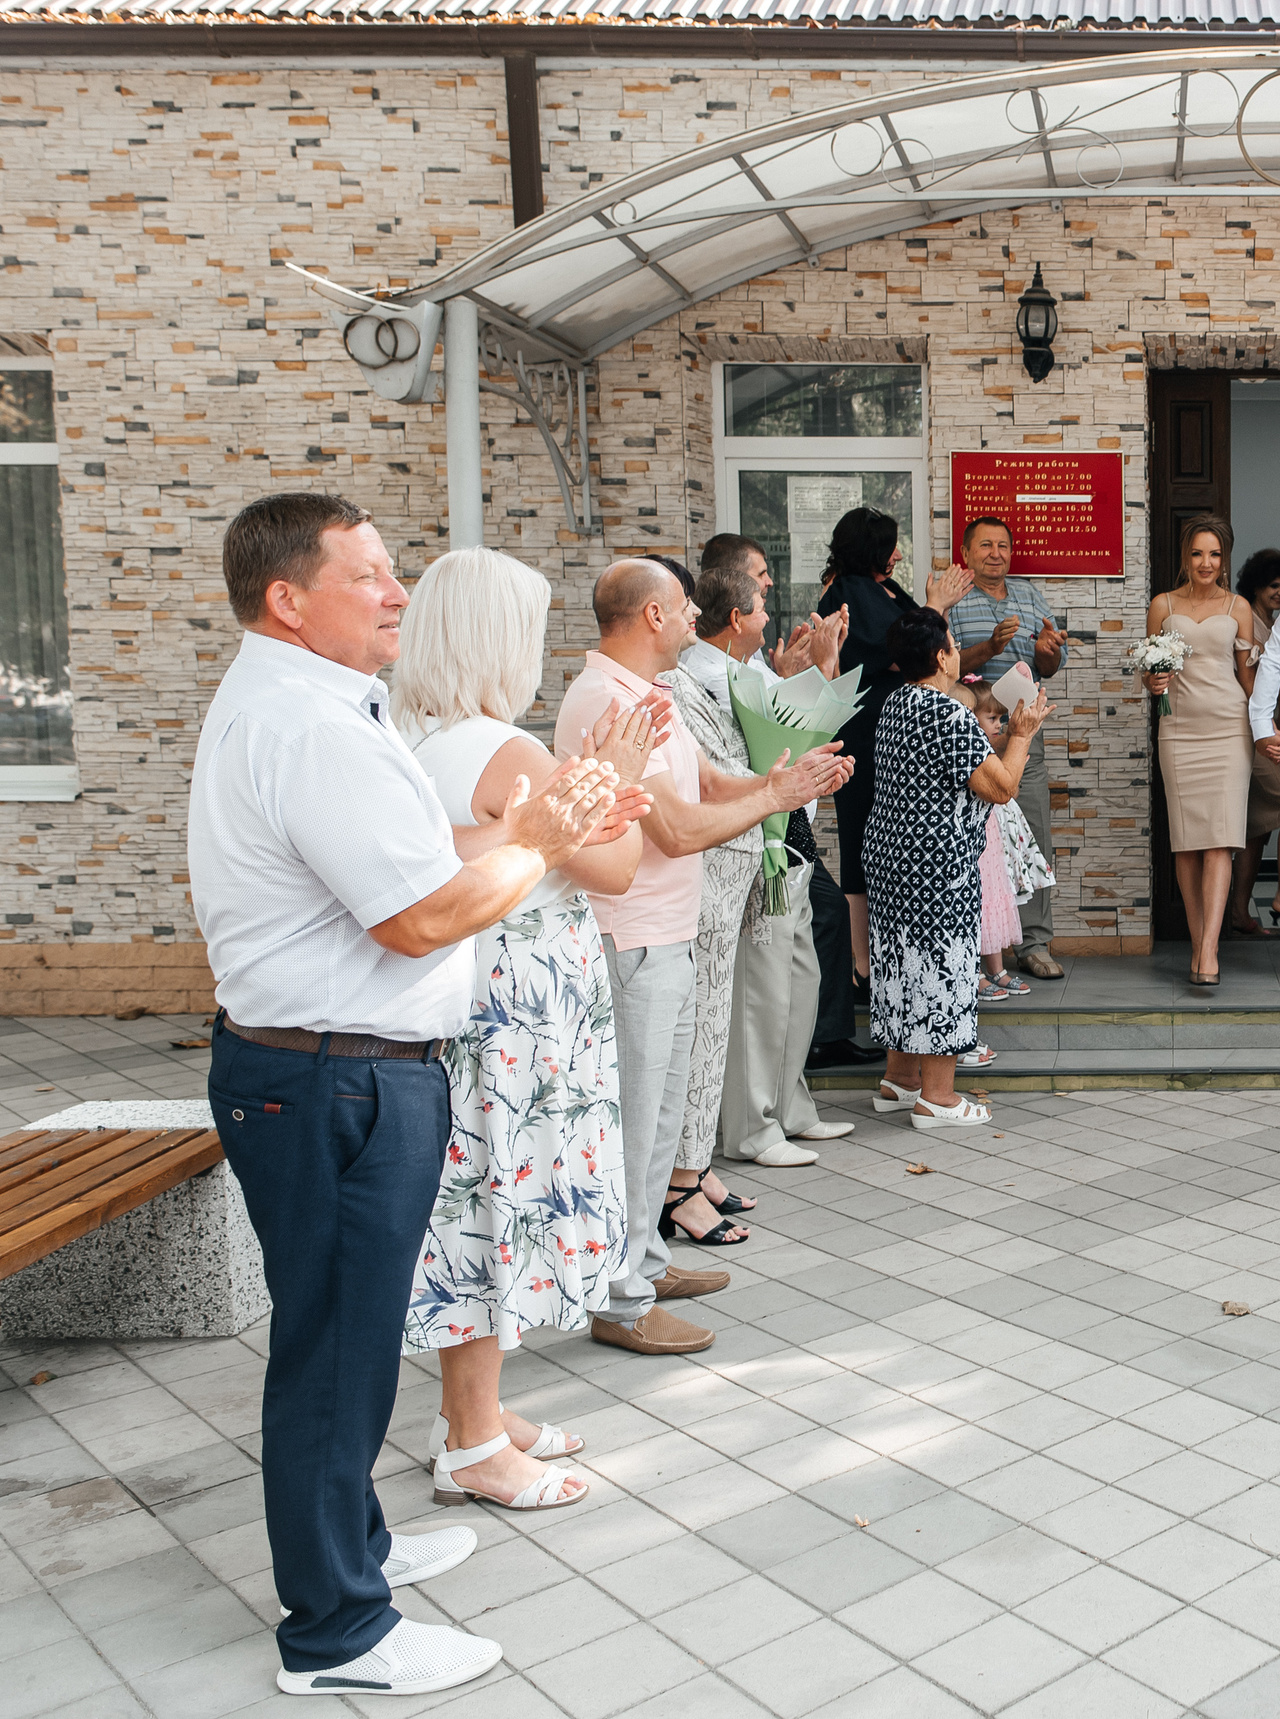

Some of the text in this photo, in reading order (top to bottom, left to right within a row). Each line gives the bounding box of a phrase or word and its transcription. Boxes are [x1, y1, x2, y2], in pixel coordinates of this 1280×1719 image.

[995, 460, 1079, 469] Режим работы
[965, 473, 1011, 481] Вторник:
[965, 484, 999, 492] Среда:
